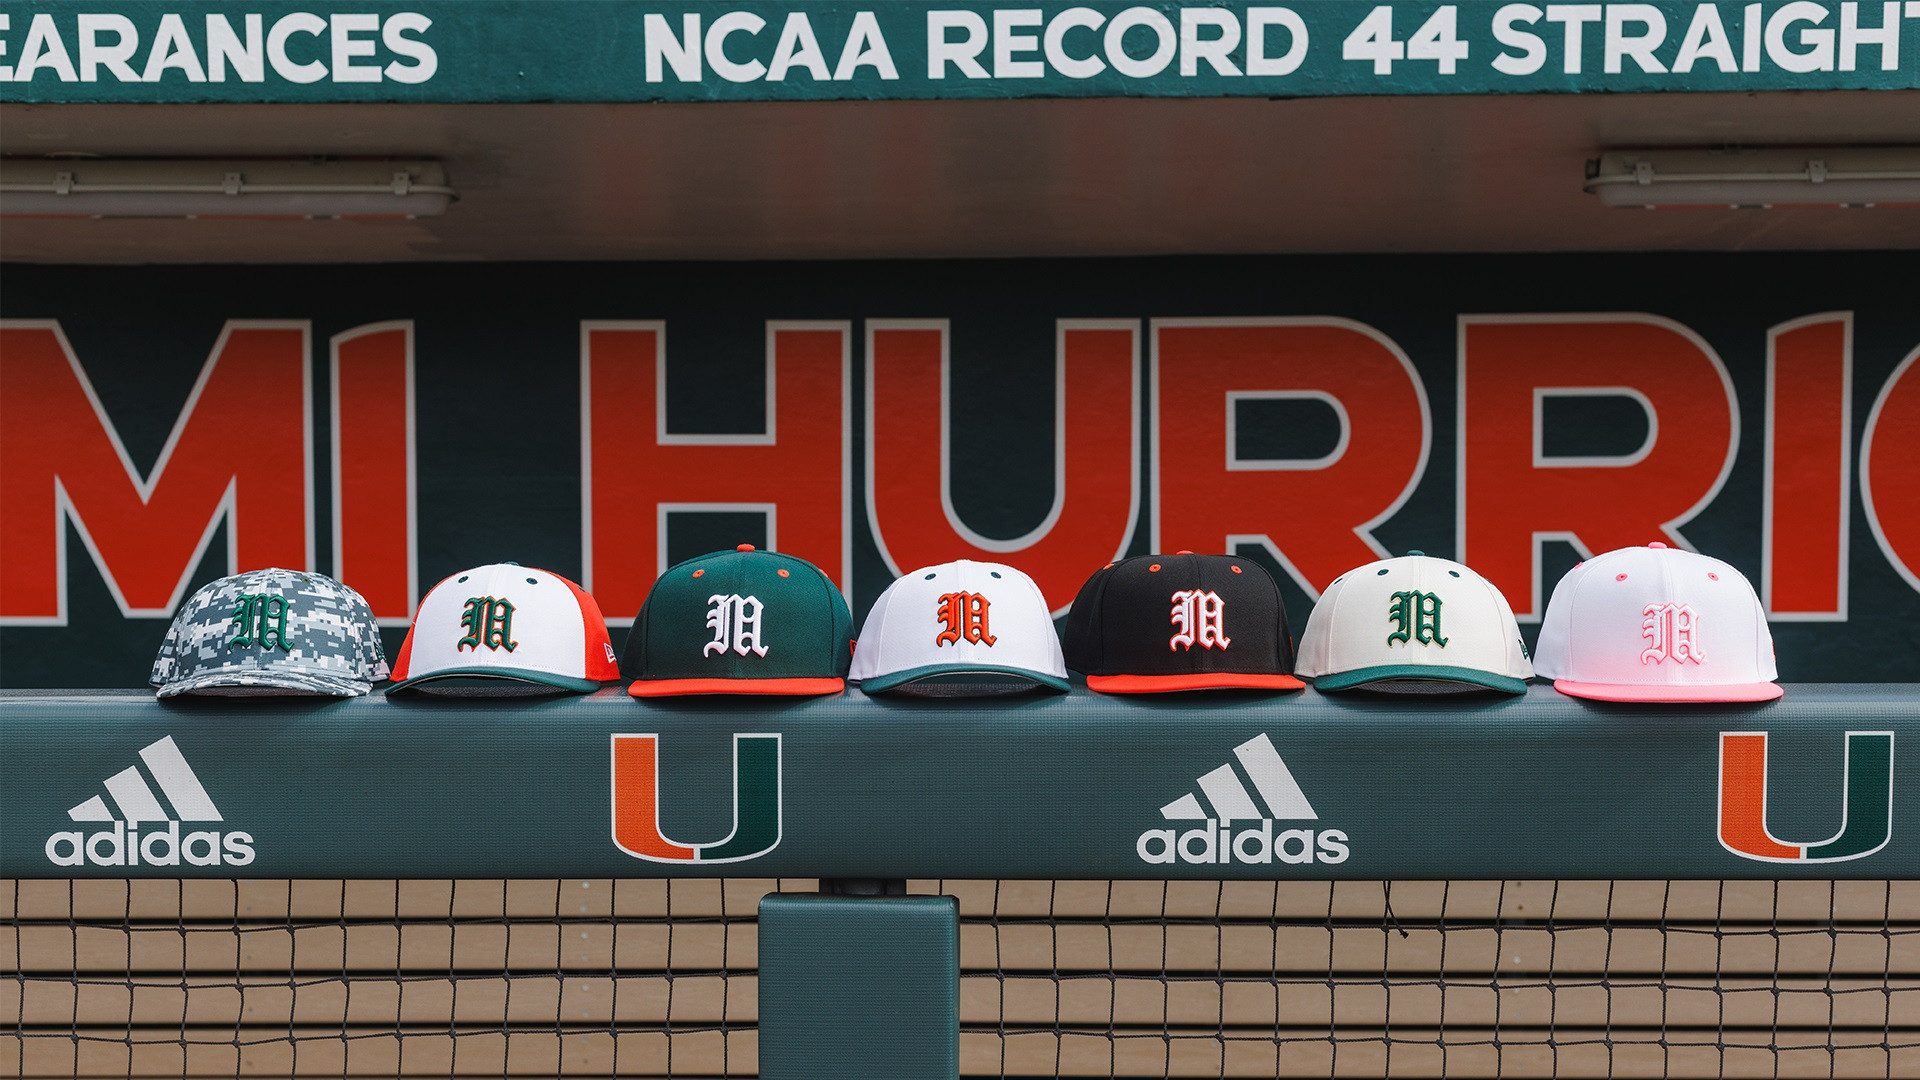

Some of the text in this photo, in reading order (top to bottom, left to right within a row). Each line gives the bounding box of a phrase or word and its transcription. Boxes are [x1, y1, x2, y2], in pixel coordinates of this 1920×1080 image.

[0, 13, 438, 84] ARANCES
[644, 12, 900, 83] NCAA
[927, 7, 1309, 79] RECORD
[1342, 5, 1469, 75] 44
[580, 311, 1920, 628] HURRI
[610, 732, 783, 865] U
[1716, 730, 1895, 864] U
[45, 819, 256, 867] adidas
[1136, 817, 1350, 865] adidas
